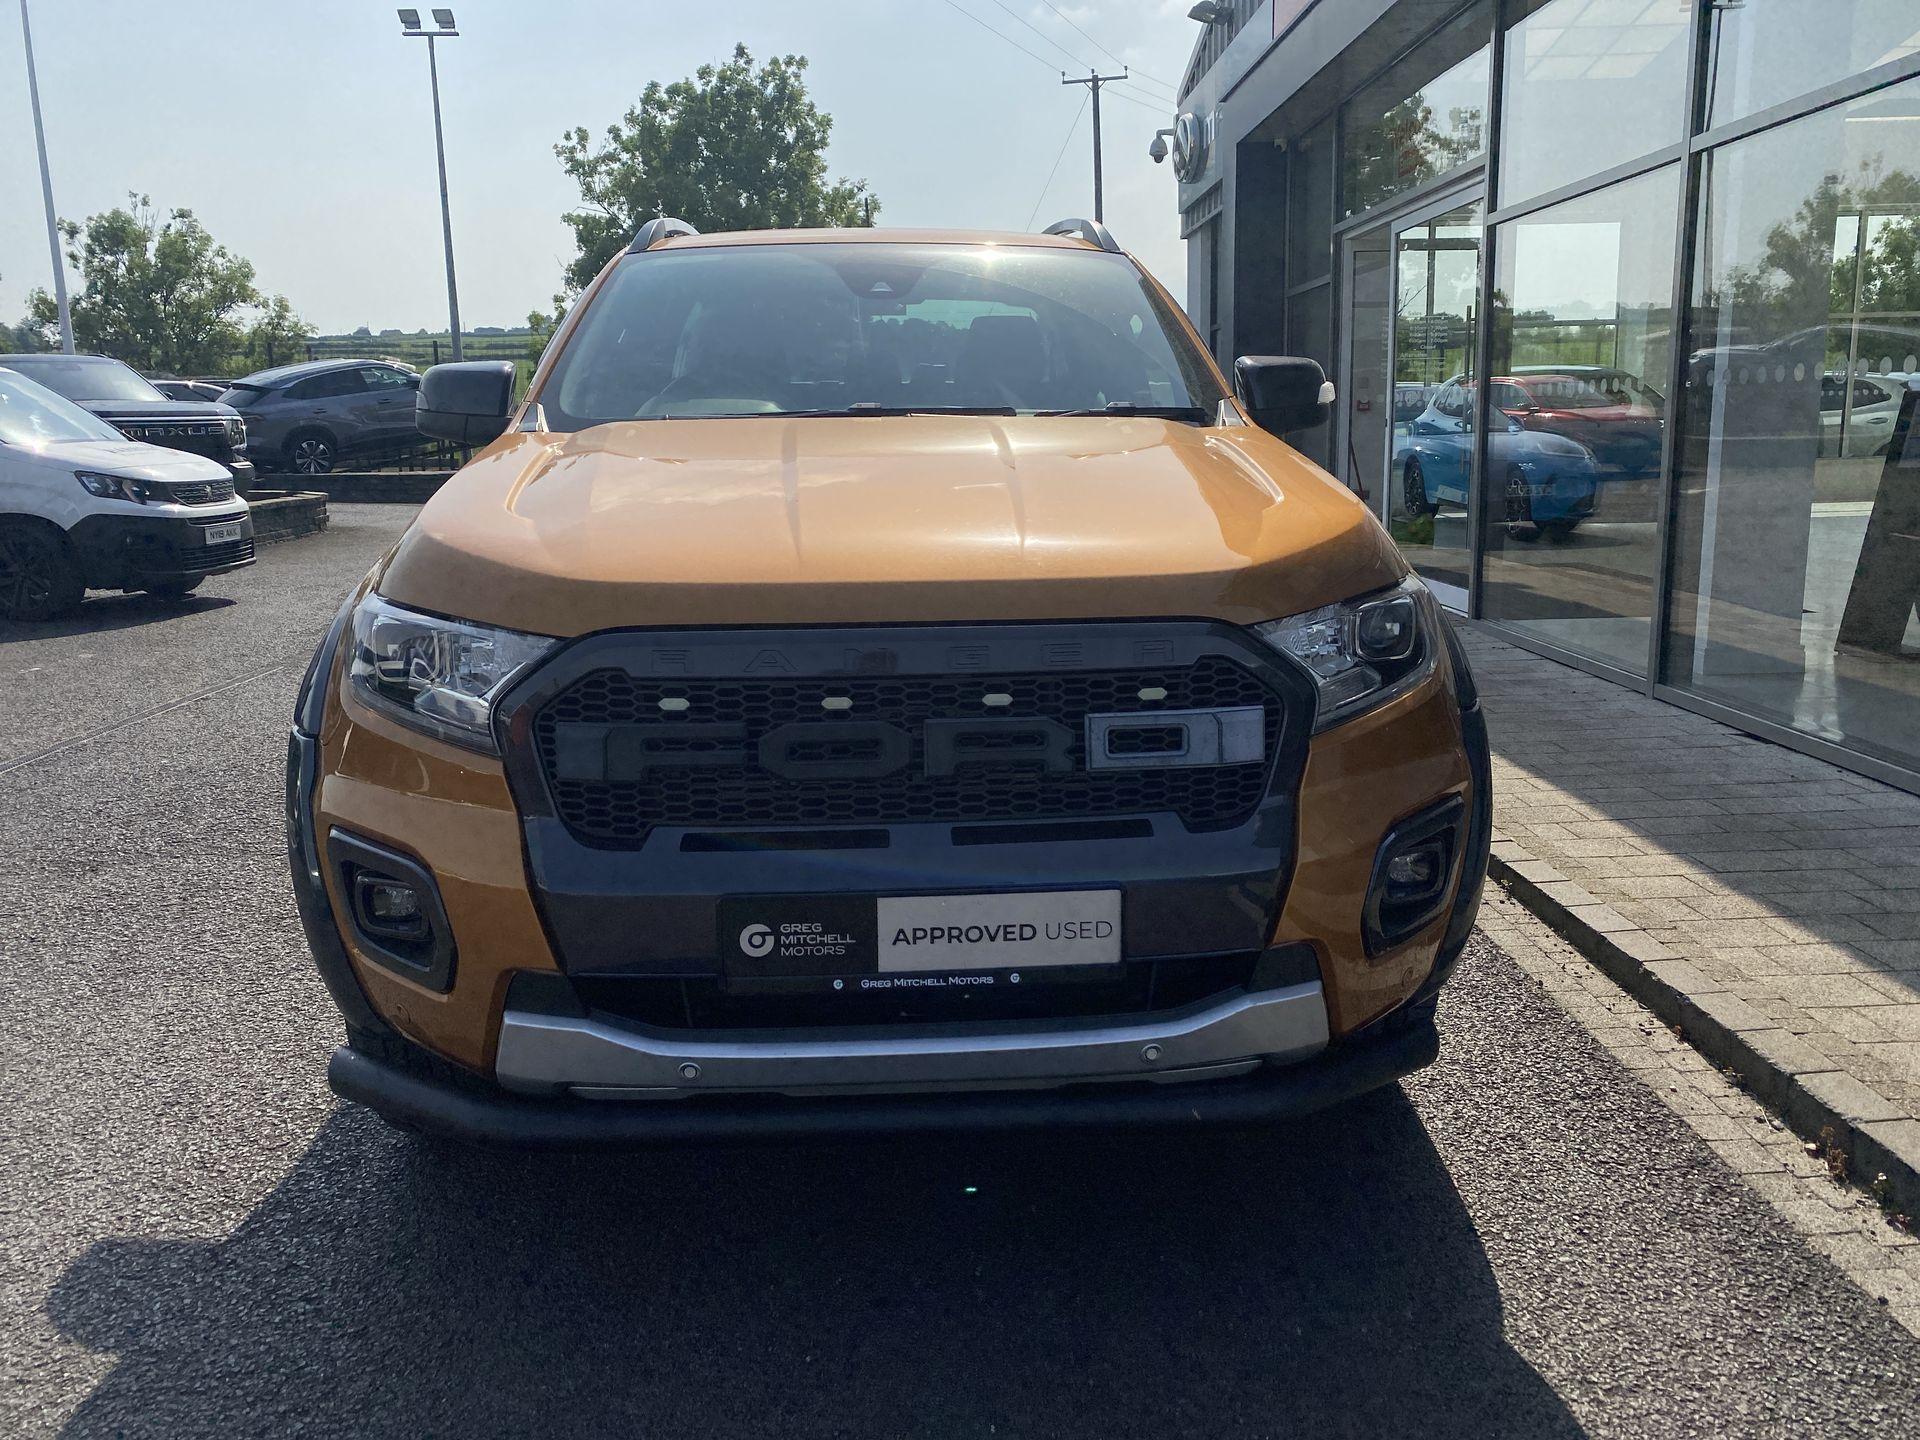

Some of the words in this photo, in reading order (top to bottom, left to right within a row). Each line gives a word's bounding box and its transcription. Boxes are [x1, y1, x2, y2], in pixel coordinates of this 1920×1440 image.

[649, 639, 1175, 674] RANGER
[555, 705, 1266, 782] FORD
[780, 923, 822, 933] GREG
[891, 923, 1037, 946] APPROVED
[1045, 920, 1113, 940] USED
[780, 933, 857, 945] MITCHELL
[780, 945, 846, 956] MOTORS
